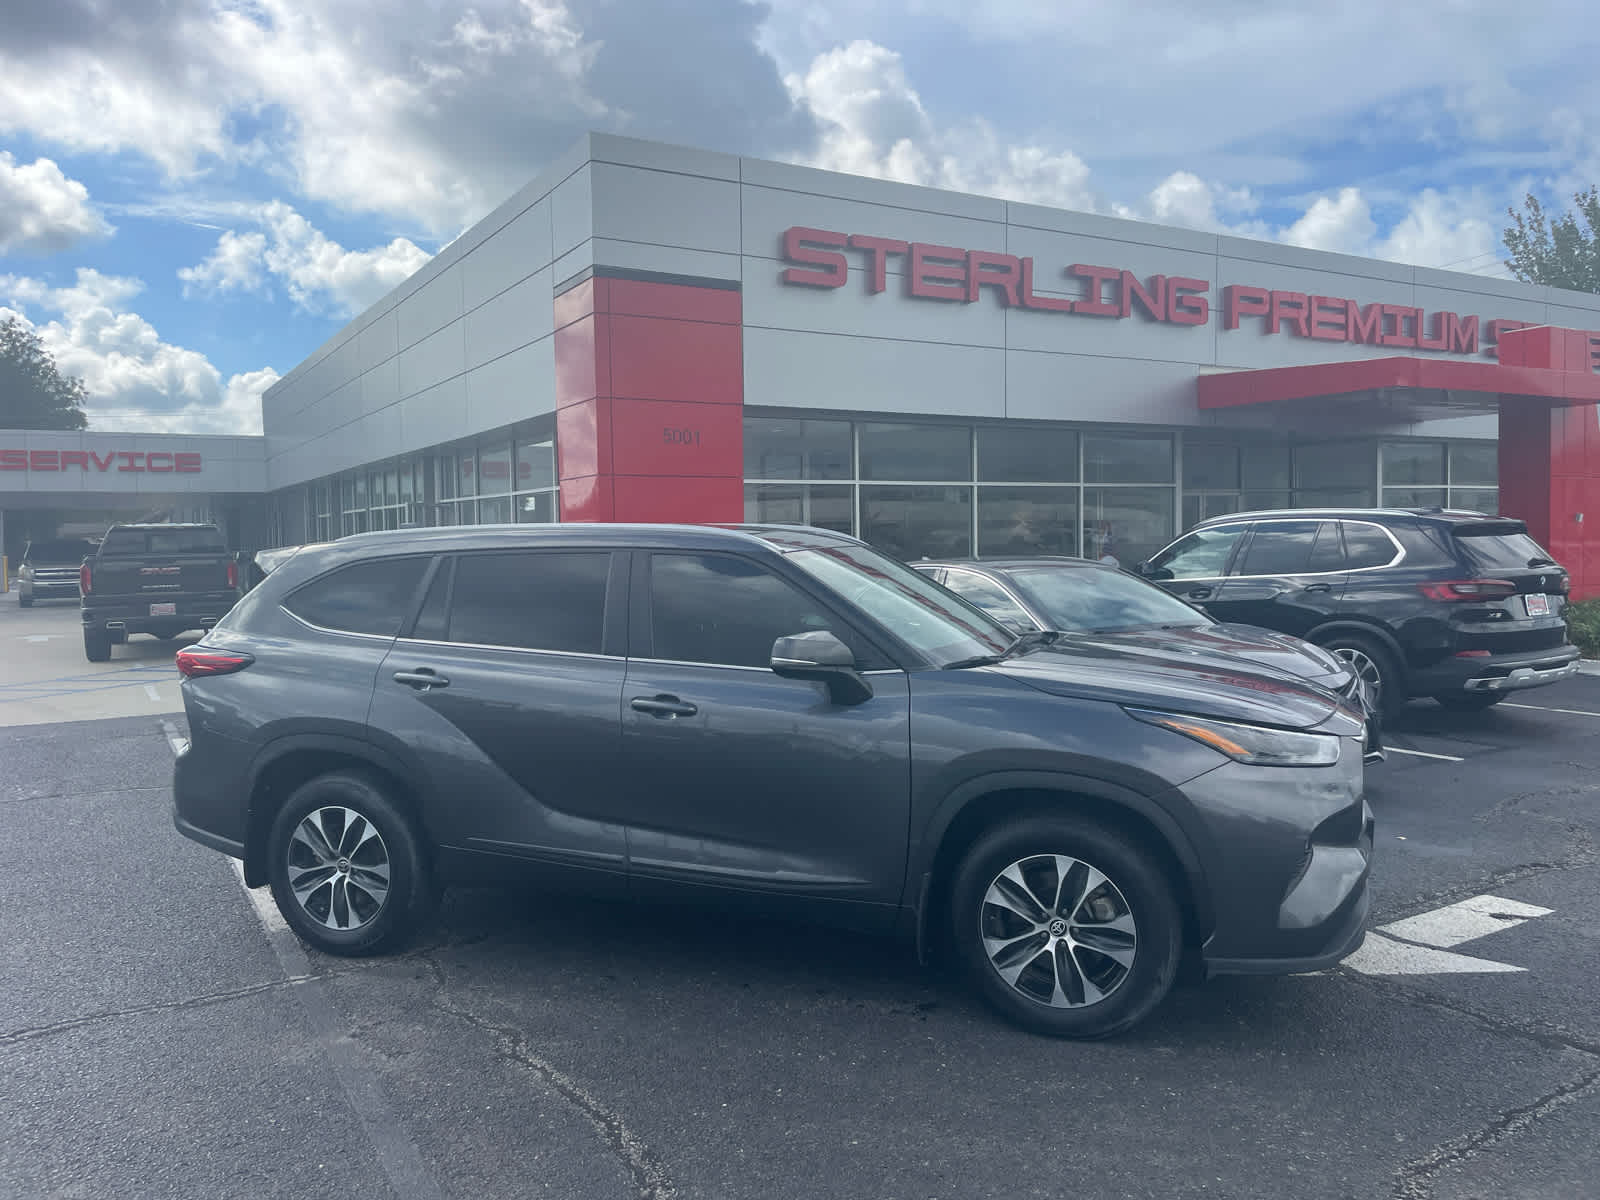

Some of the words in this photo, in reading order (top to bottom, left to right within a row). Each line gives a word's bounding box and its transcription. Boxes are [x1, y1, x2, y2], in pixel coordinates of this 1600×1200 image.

[782, 226, 1210, 327] STERLING
[1223, 284, 1479, 354] PREMIUM
[663, 427, 701, 447] 5001
[0, 449, 202, 473] SERVICE
